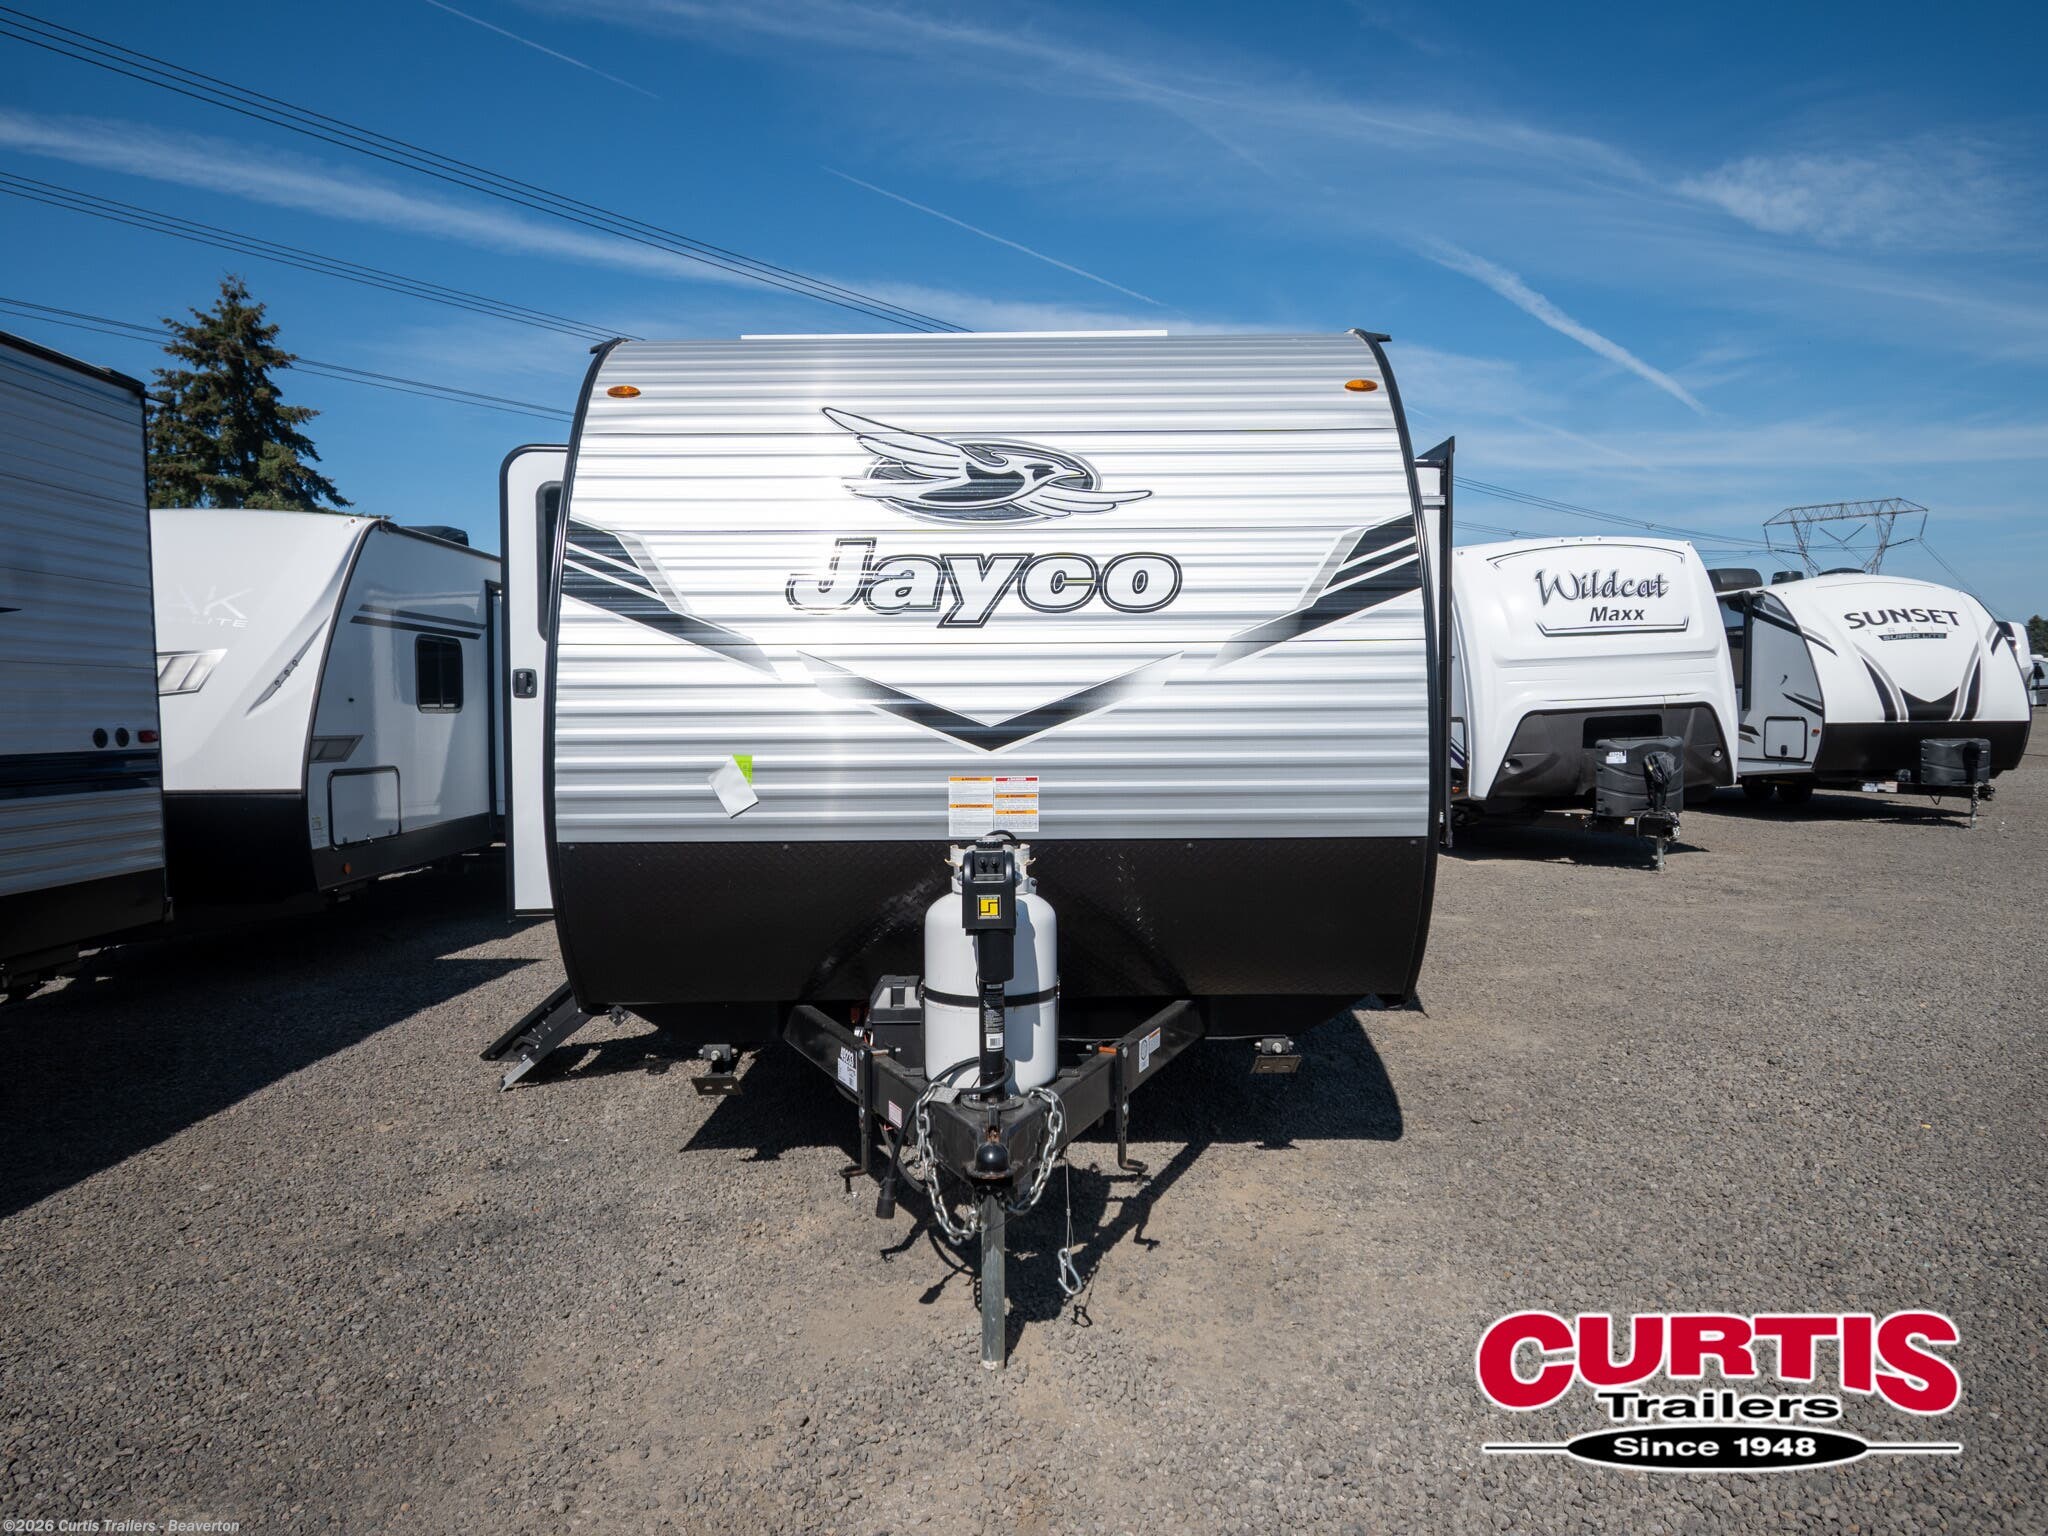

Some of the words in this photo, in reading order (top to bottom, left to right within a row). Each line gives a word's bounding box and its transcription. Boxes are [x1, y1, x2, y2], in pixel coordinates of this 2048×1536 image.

[785, 537, 1183, 628] Jayco
[1535, 569, 1670, 606] Wildcat
[1589, 606, 1645, 622] Maxx
[1844, 608, 1960, 629] SUNSET
